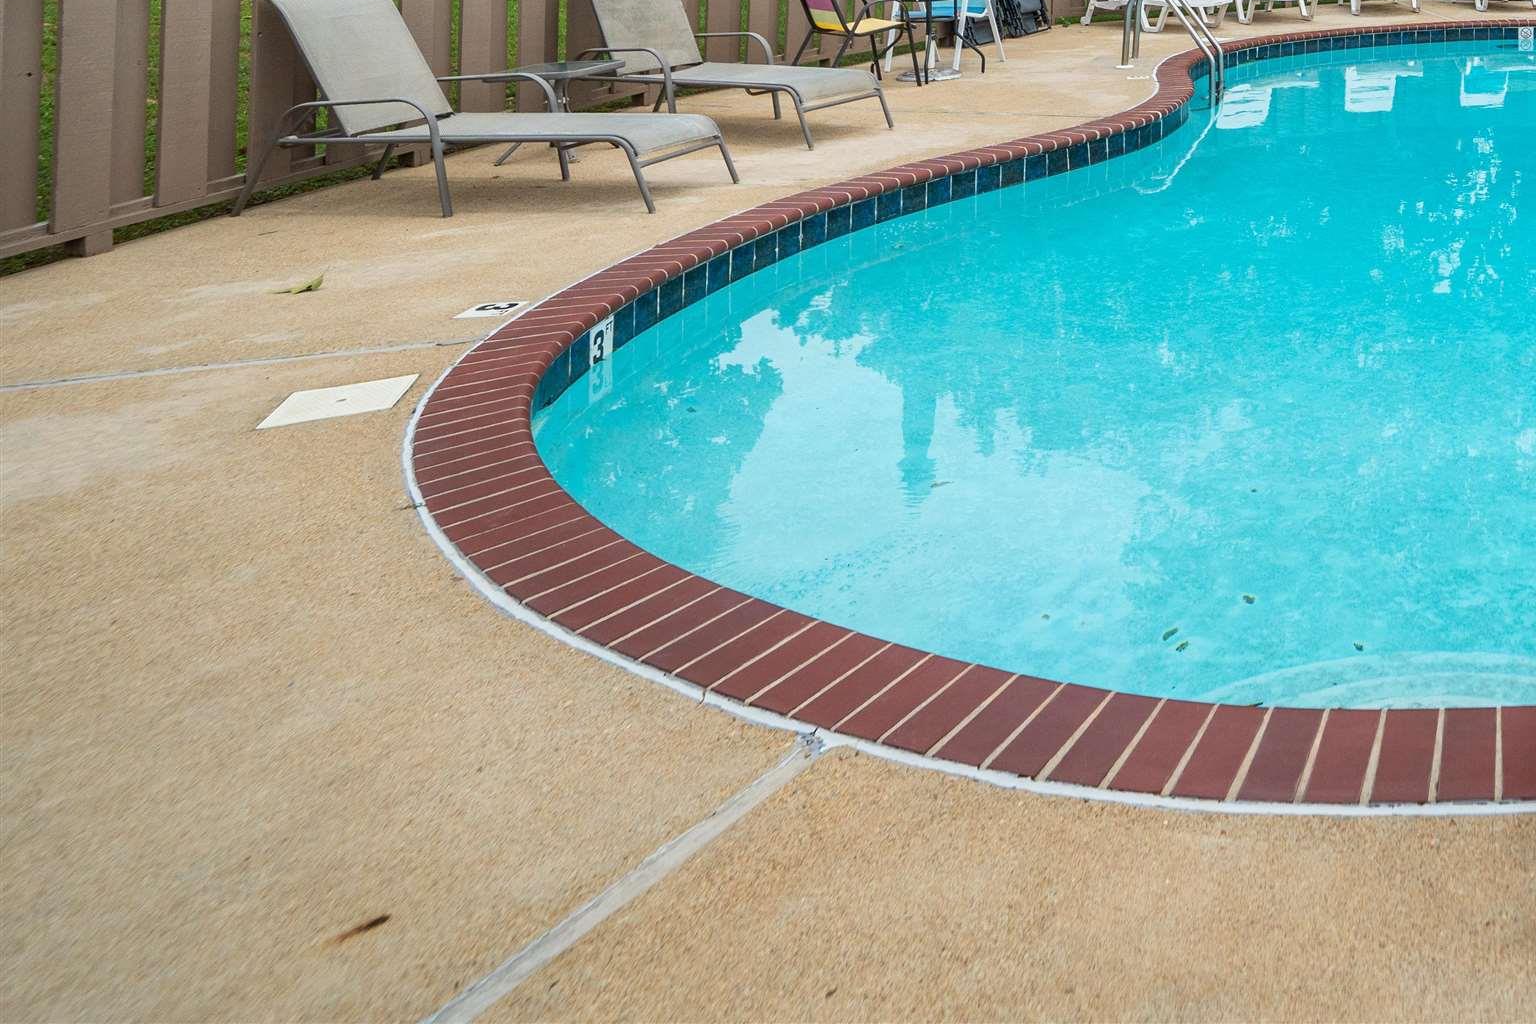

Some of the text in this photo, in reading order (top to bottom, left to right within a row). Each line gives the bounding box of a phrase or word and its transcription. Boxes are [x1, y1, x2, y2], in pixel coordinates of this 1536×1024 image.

[475, 303, 519, 311] 3
[593, 320, 614, 364] 3 FT
